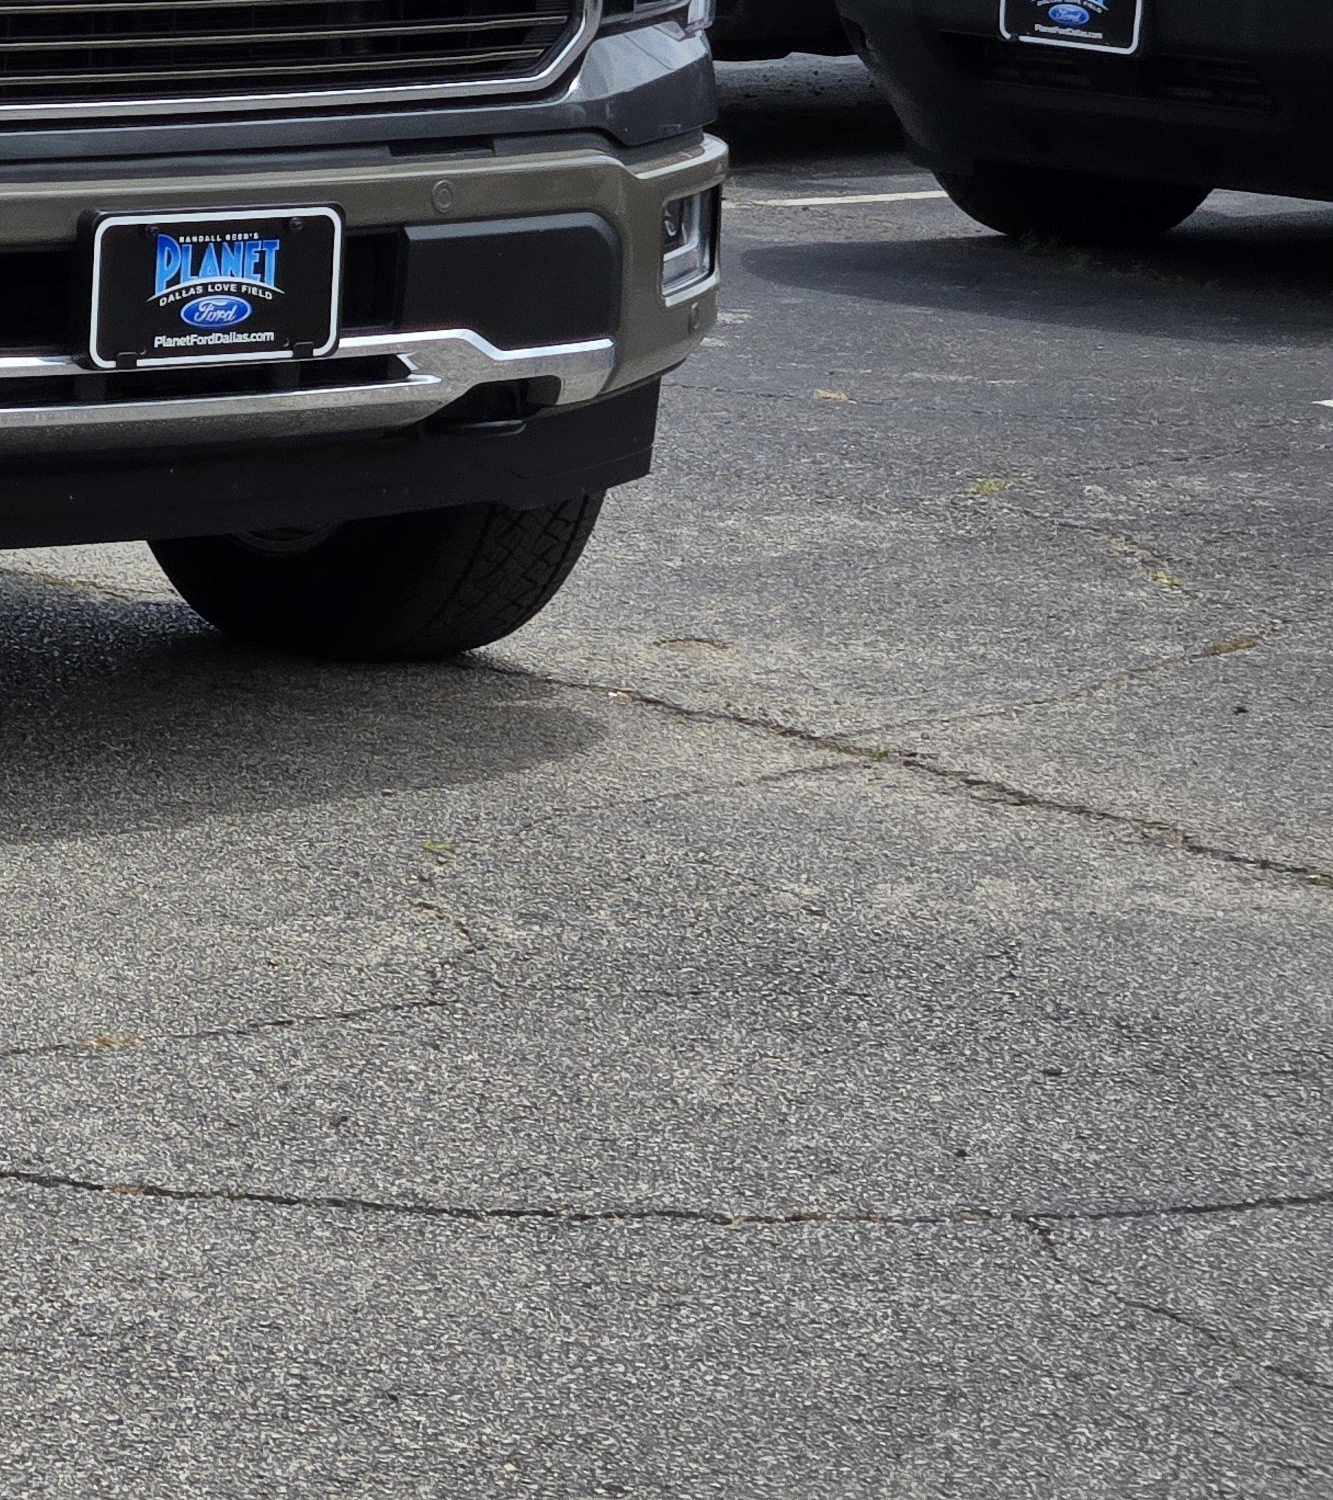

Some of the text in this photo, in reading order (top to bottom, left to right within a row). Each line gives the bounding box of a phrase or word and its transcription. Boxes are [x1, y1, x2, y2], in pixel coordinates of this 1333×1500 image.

[155, 233, 280, 297] PLANET
[159, 283, 273, 307] DALLAS LOVE FIELD
[194, 300, 238, 322] Ford
[153, 332, 275, 348] PlanetFordDallas.com
